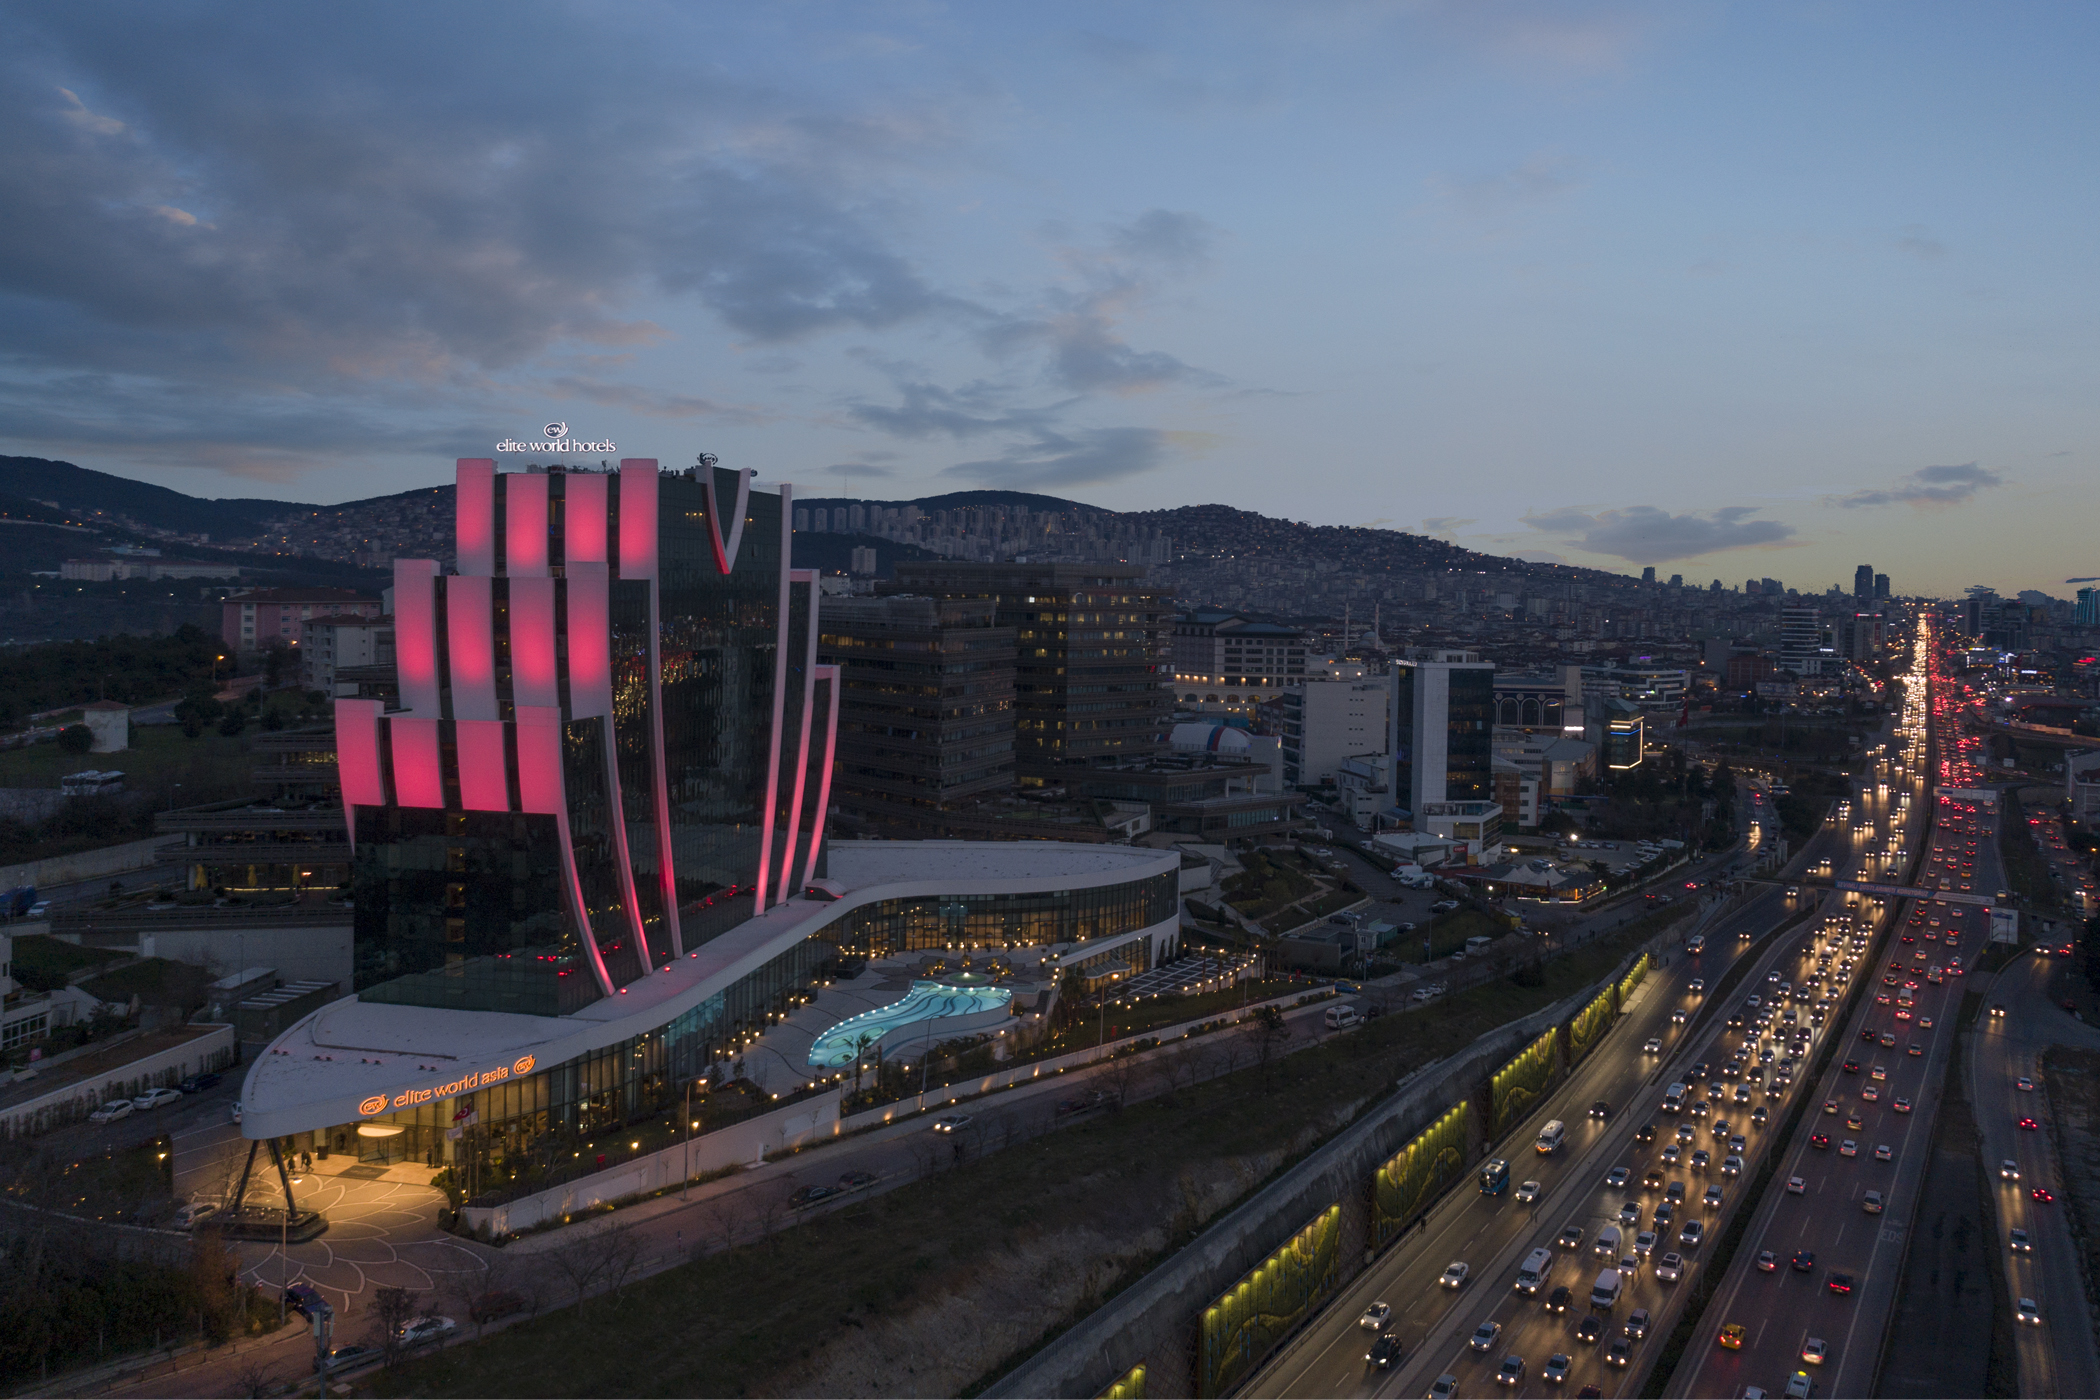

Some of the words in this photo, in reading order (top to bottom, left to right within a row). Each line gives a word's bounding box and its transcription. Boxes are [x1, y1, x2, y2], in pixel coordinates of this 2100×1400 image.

[496, 439, 527, 452] elite
[529, 438, 570, 452] world
[573, 438, 617, 452] hotels
[394, 1090, 432, 1107] elite
[434, 1072, 479, 1098] world
[481, 1067, 509, 1085] asia
